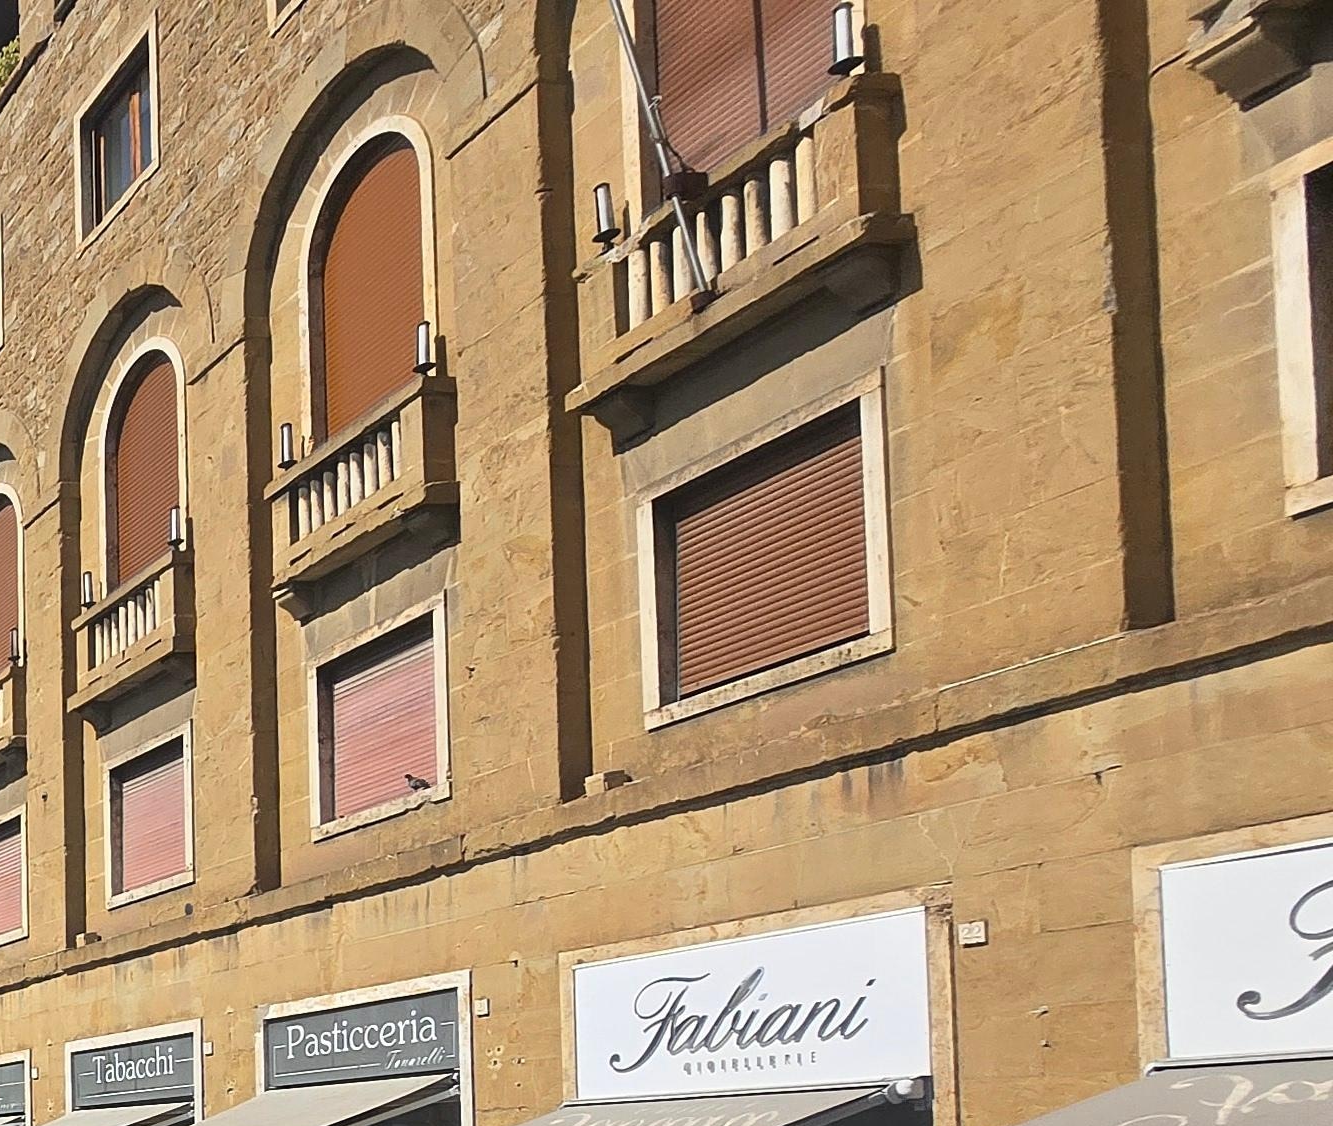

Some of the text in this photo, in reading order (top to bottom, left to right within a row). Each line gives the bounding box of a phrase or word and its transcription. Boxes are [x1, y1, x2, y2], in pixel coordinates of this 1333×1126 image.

[962, 924, 982, 940] 22
[286, 1009, 438, 1060] Pasticceria
[609, 966, 876, 1073] Fabiani
[92, 1045, 174, 1084] Tabacchi
